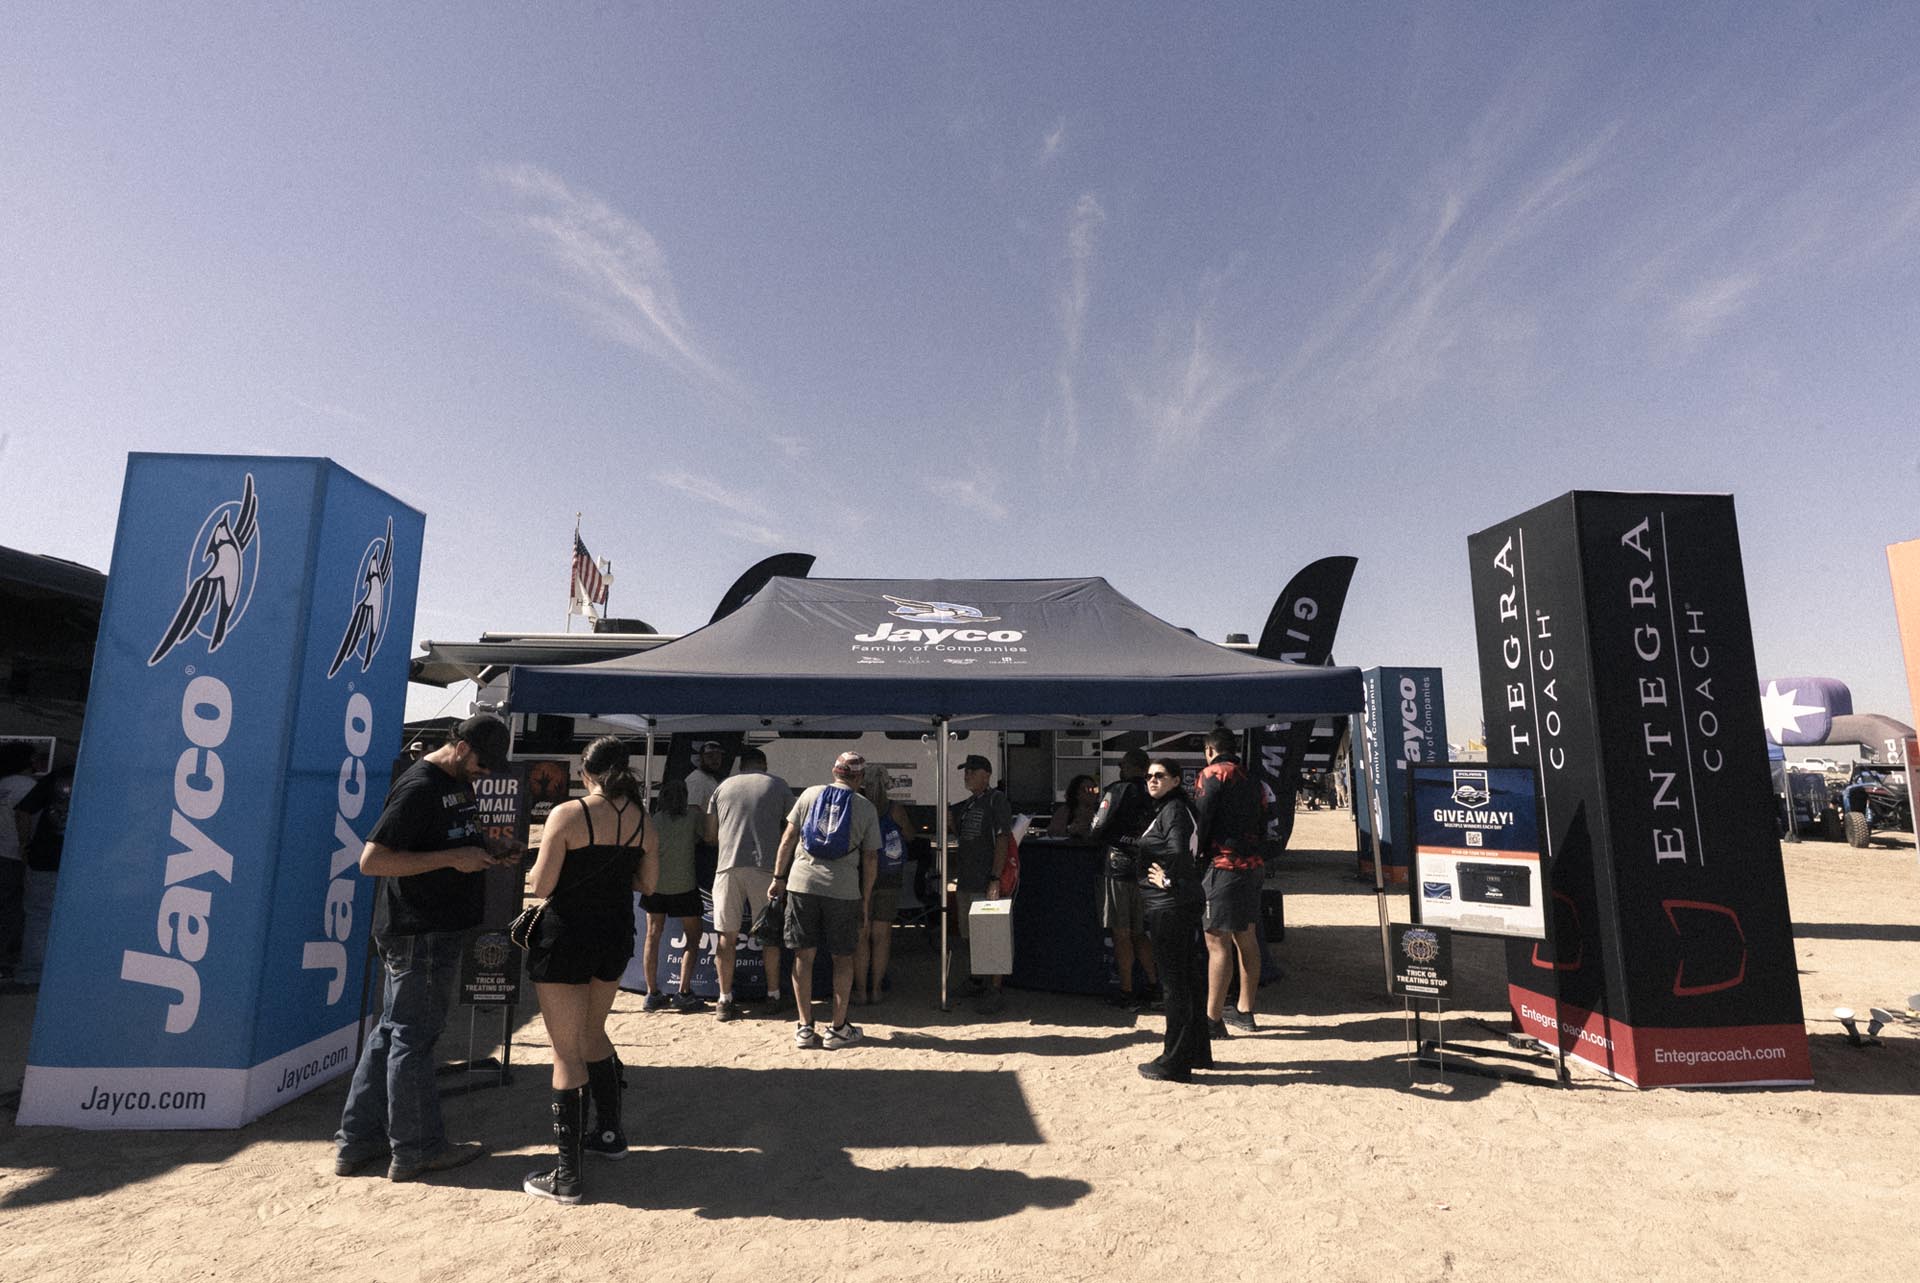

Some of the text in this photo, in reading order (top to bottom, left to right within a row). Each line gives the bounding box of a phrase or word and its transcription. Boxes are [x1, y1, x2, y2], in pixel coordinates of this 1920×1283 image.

[854, 623, 1024, 645] Jayco
[935, 644, 1028, 653] Companies
[1494, 535, 1530, 755] TEGRA
[1537, 614, 1564, 769] COACH
[1621, 516, 1687, 864] ENTEGRA
[1687, 610, 1723, 772] COACH
[1368, 678, 1377, 735] Companies
[1422, 677, 1433, 734] Companies
[1397, 677, 1424, 769] ayco
[472, 779, 519, 796] YOUR
[476, 798, 517, 812] MAIL
[492, 814, 516, 824] WIN!
[1433, 809, 1514, 825] GIVEAWAY!
[120, 675, 233, 1034] Jayco
[302, 692, 373, 1007] Jayco
[700, 956, 711, 965] of
[1407, 969, 1426, 978] TRICK
[465, 984, 515, 992] TREATING STOP
[1397, 975, 1448, 987] TREATING STOP
[1521, 1004, 1615, 1051] Entegraoach.com
[277, 1045, 349, 1093] Jayco.com
[1654, 1047, 1787, 1066] Entegracoach.com
[81, 1086, 206, 1115] Jayco.com
